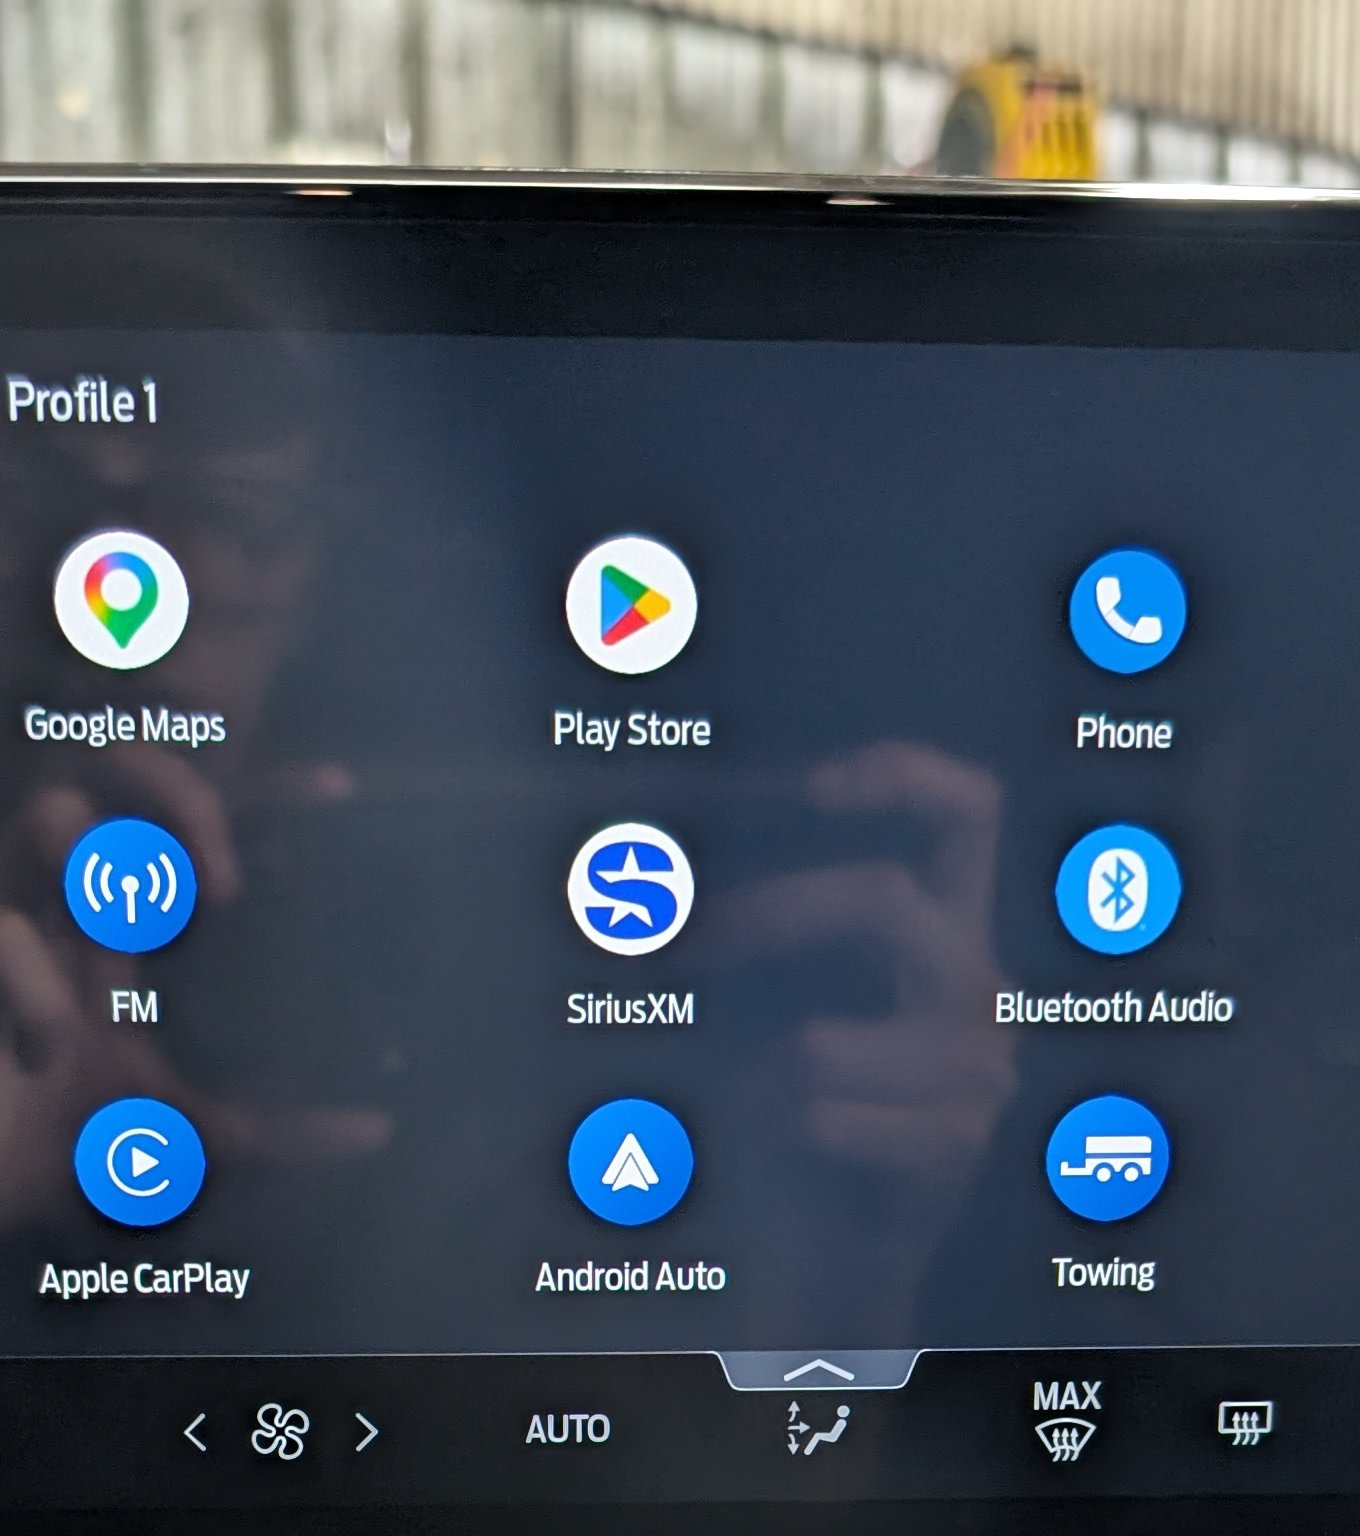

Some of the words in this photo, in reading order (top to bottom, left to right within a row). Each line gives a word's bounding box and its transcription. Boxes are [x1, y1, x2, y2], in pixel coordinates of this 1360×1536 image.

[8, 376, 136, 424] Profile
[144, 380, 158, 425] 1
[25, 706, 137, 749] Google
[142, 708, 227, 750] Maps
[554, 711, 621, 753] Play
[628, 713, 712, 747] Store
[1077, 714, 1174, 750] Phone
[112, 991, 159, 1024] FM
[568, 993, 695, 1025] SiriusXM
[996, 991, 1144, 1024] Bluetooth
[1148, 990, 1236, 1024] Audio
[40, 1262, 130, 1301] Apple
[134, 1262, 252, 1301] CarPlay
[536, 1261, 650, 1293] Android
[656, 1262, 727, 1292] Auto
[1052, 1257, 1157, 1293] Towing
[1034, 1381, 1103, 1412] MAX
[526, 1414, 612, 1445] AUTO
